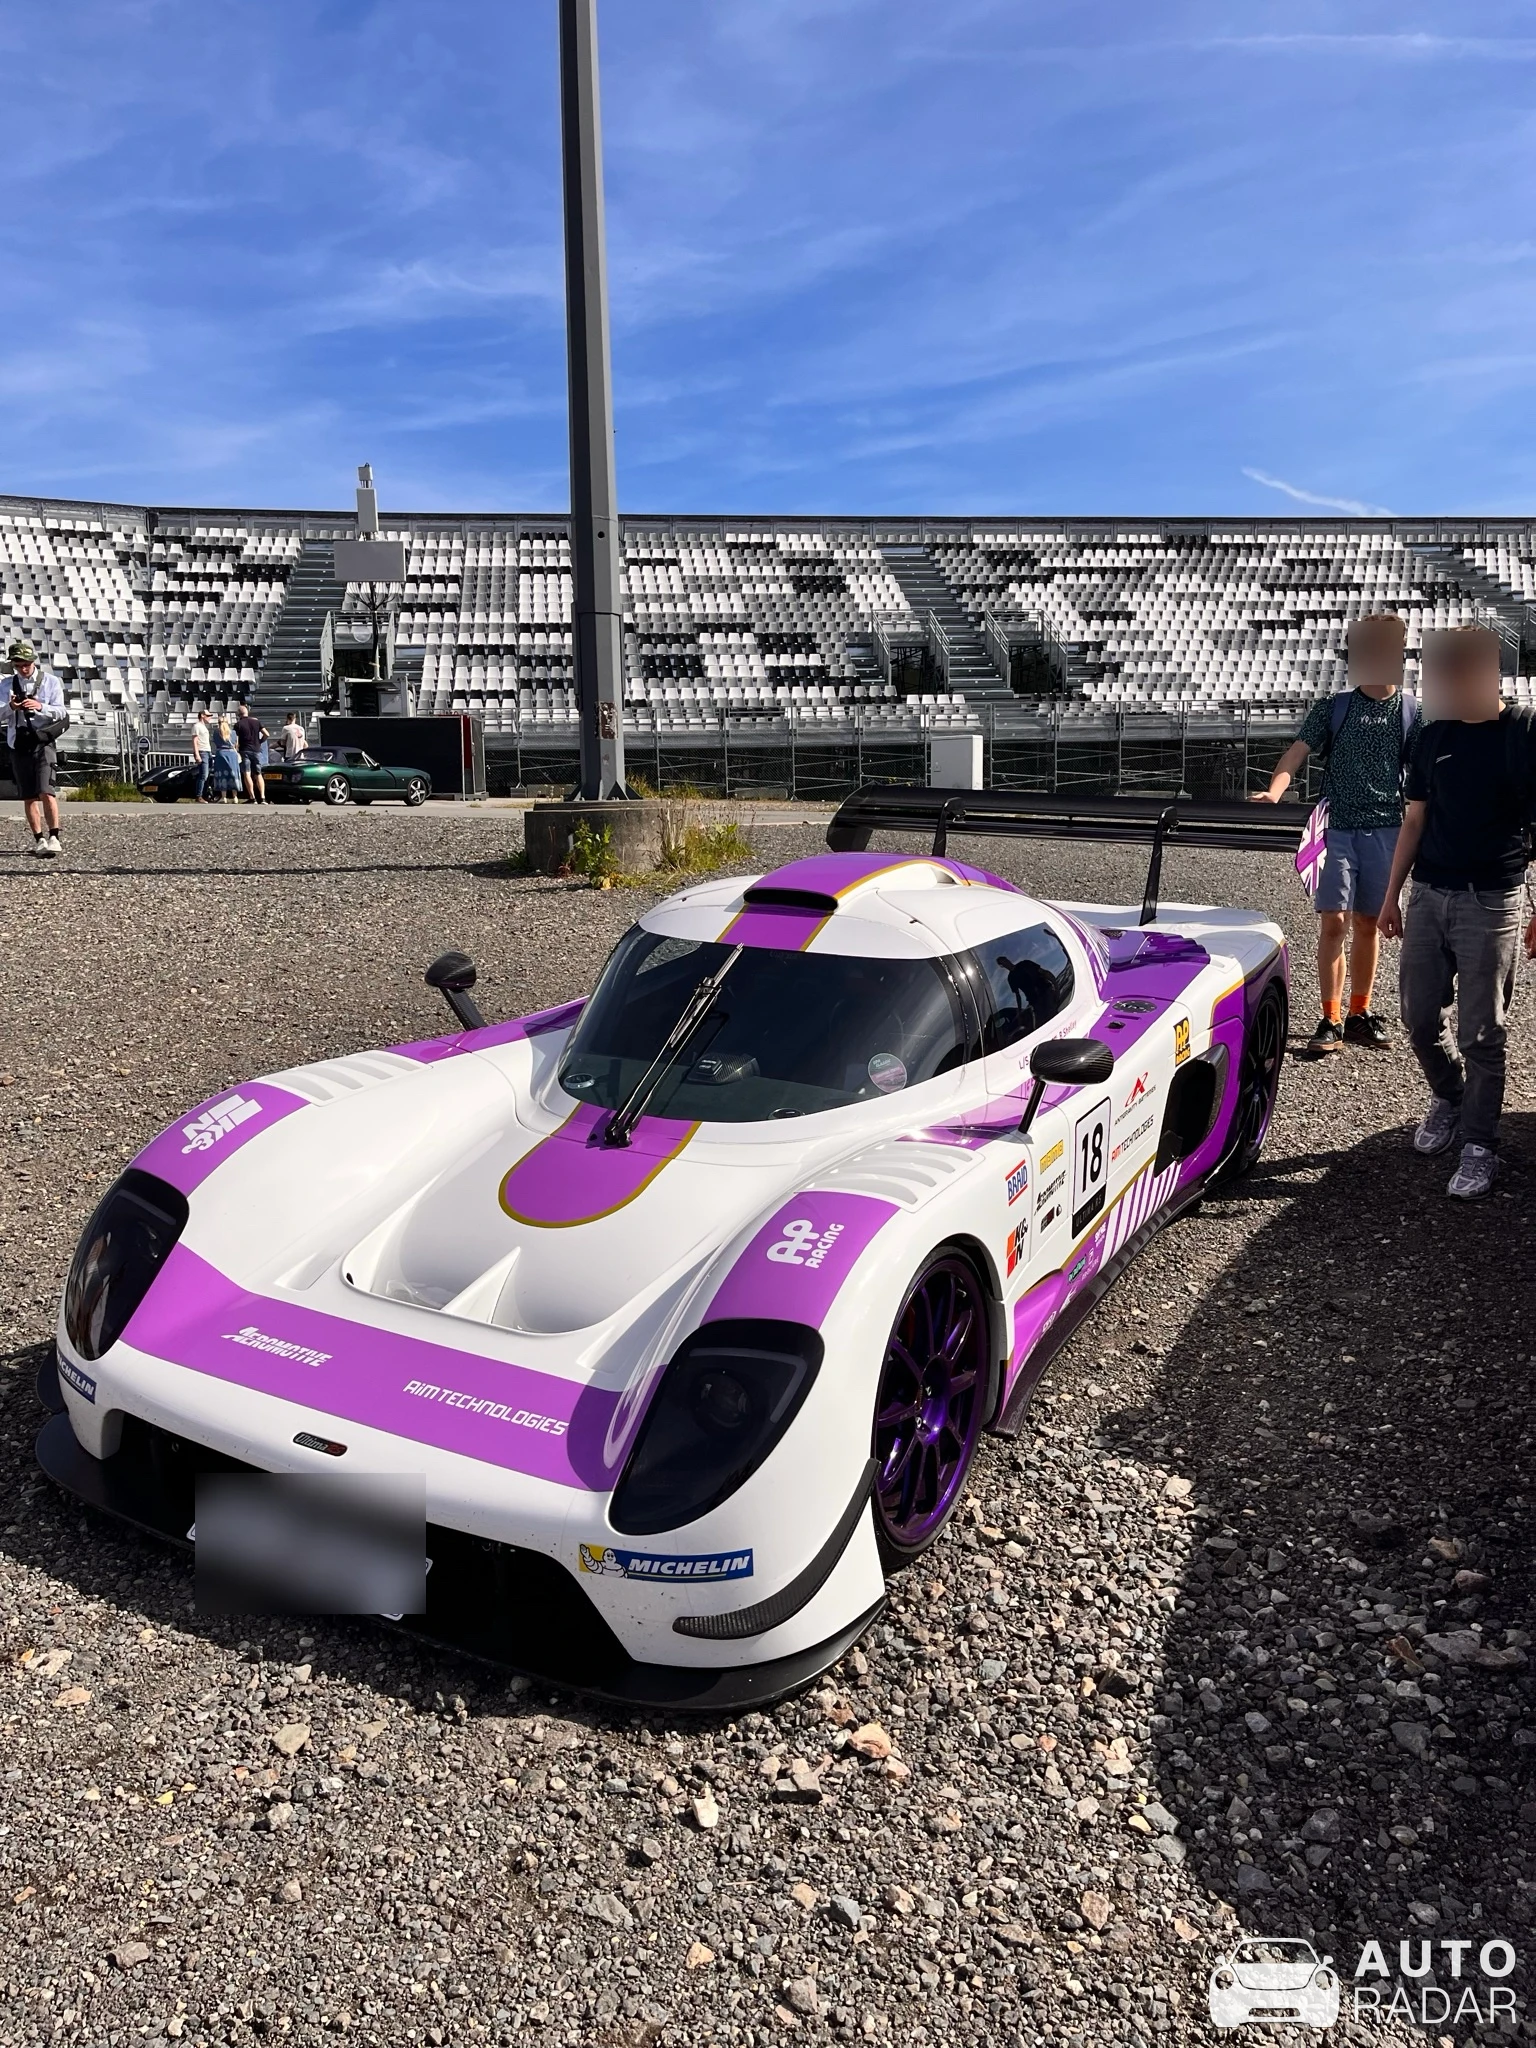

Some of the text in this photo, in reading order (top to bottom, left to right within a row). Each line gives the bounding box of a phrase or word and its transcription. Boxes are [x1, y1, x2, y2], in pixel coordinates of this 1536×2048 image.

[1082, 1122, 1103, 1193] 18
[1007, 1165, 1029, 1201] BRAID
[766, 1219, 820, 1265] AP
[804, 1223, 845, 1269] RACING
[221, 1326, 334, 1367] AEROMOTIVE
[629, 1555, 750, 1575] MICHELIN
